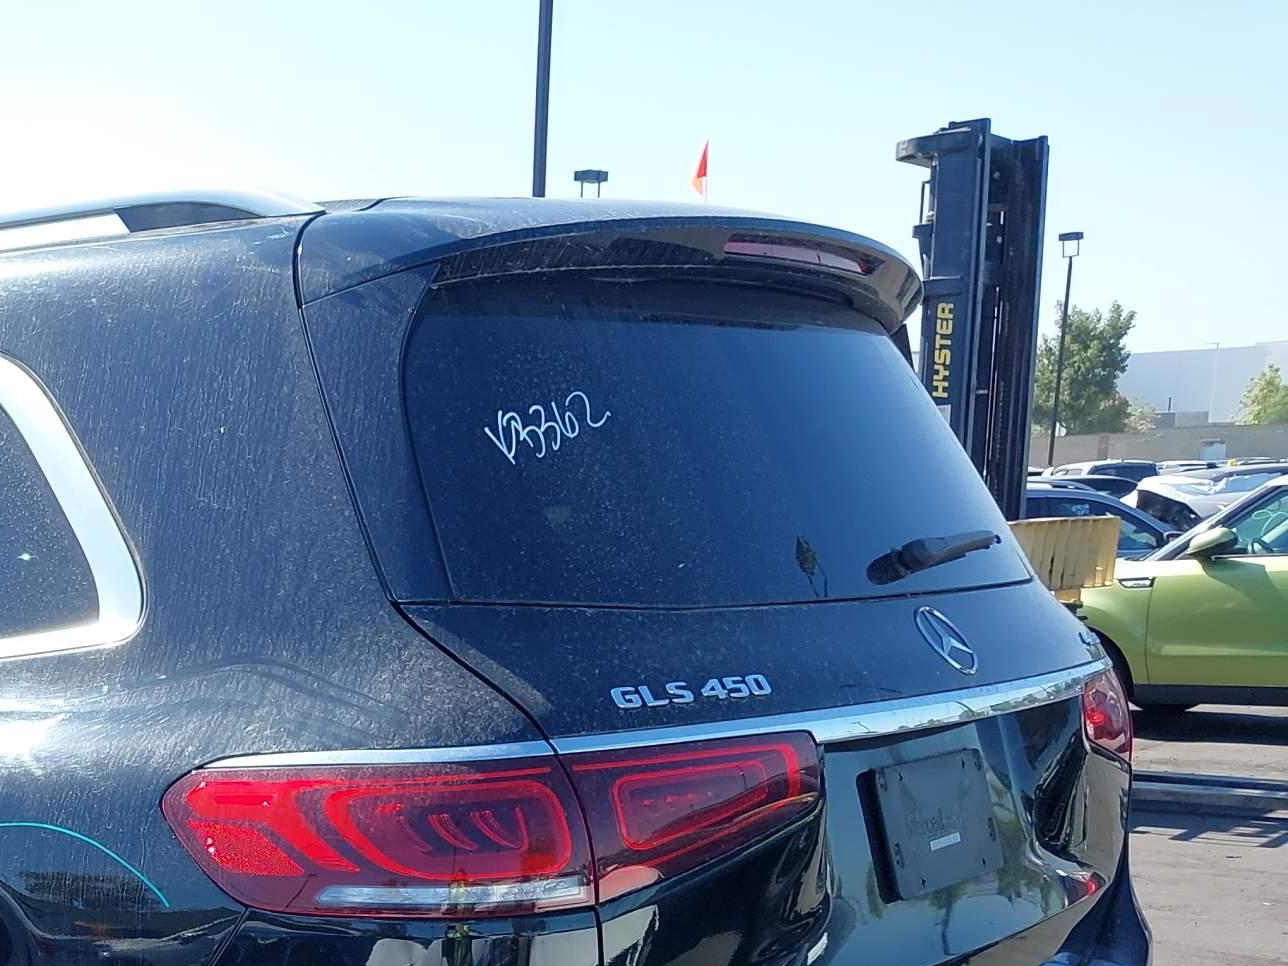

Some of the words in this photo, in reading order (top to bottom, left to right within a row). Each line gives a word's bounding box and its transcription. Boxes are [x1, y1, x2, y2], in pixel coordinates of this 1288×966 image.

[931, 302, 955, 399] HYSTER
[610, 681, 695, 709] GLS
[700, 673, 772, 699] 450
